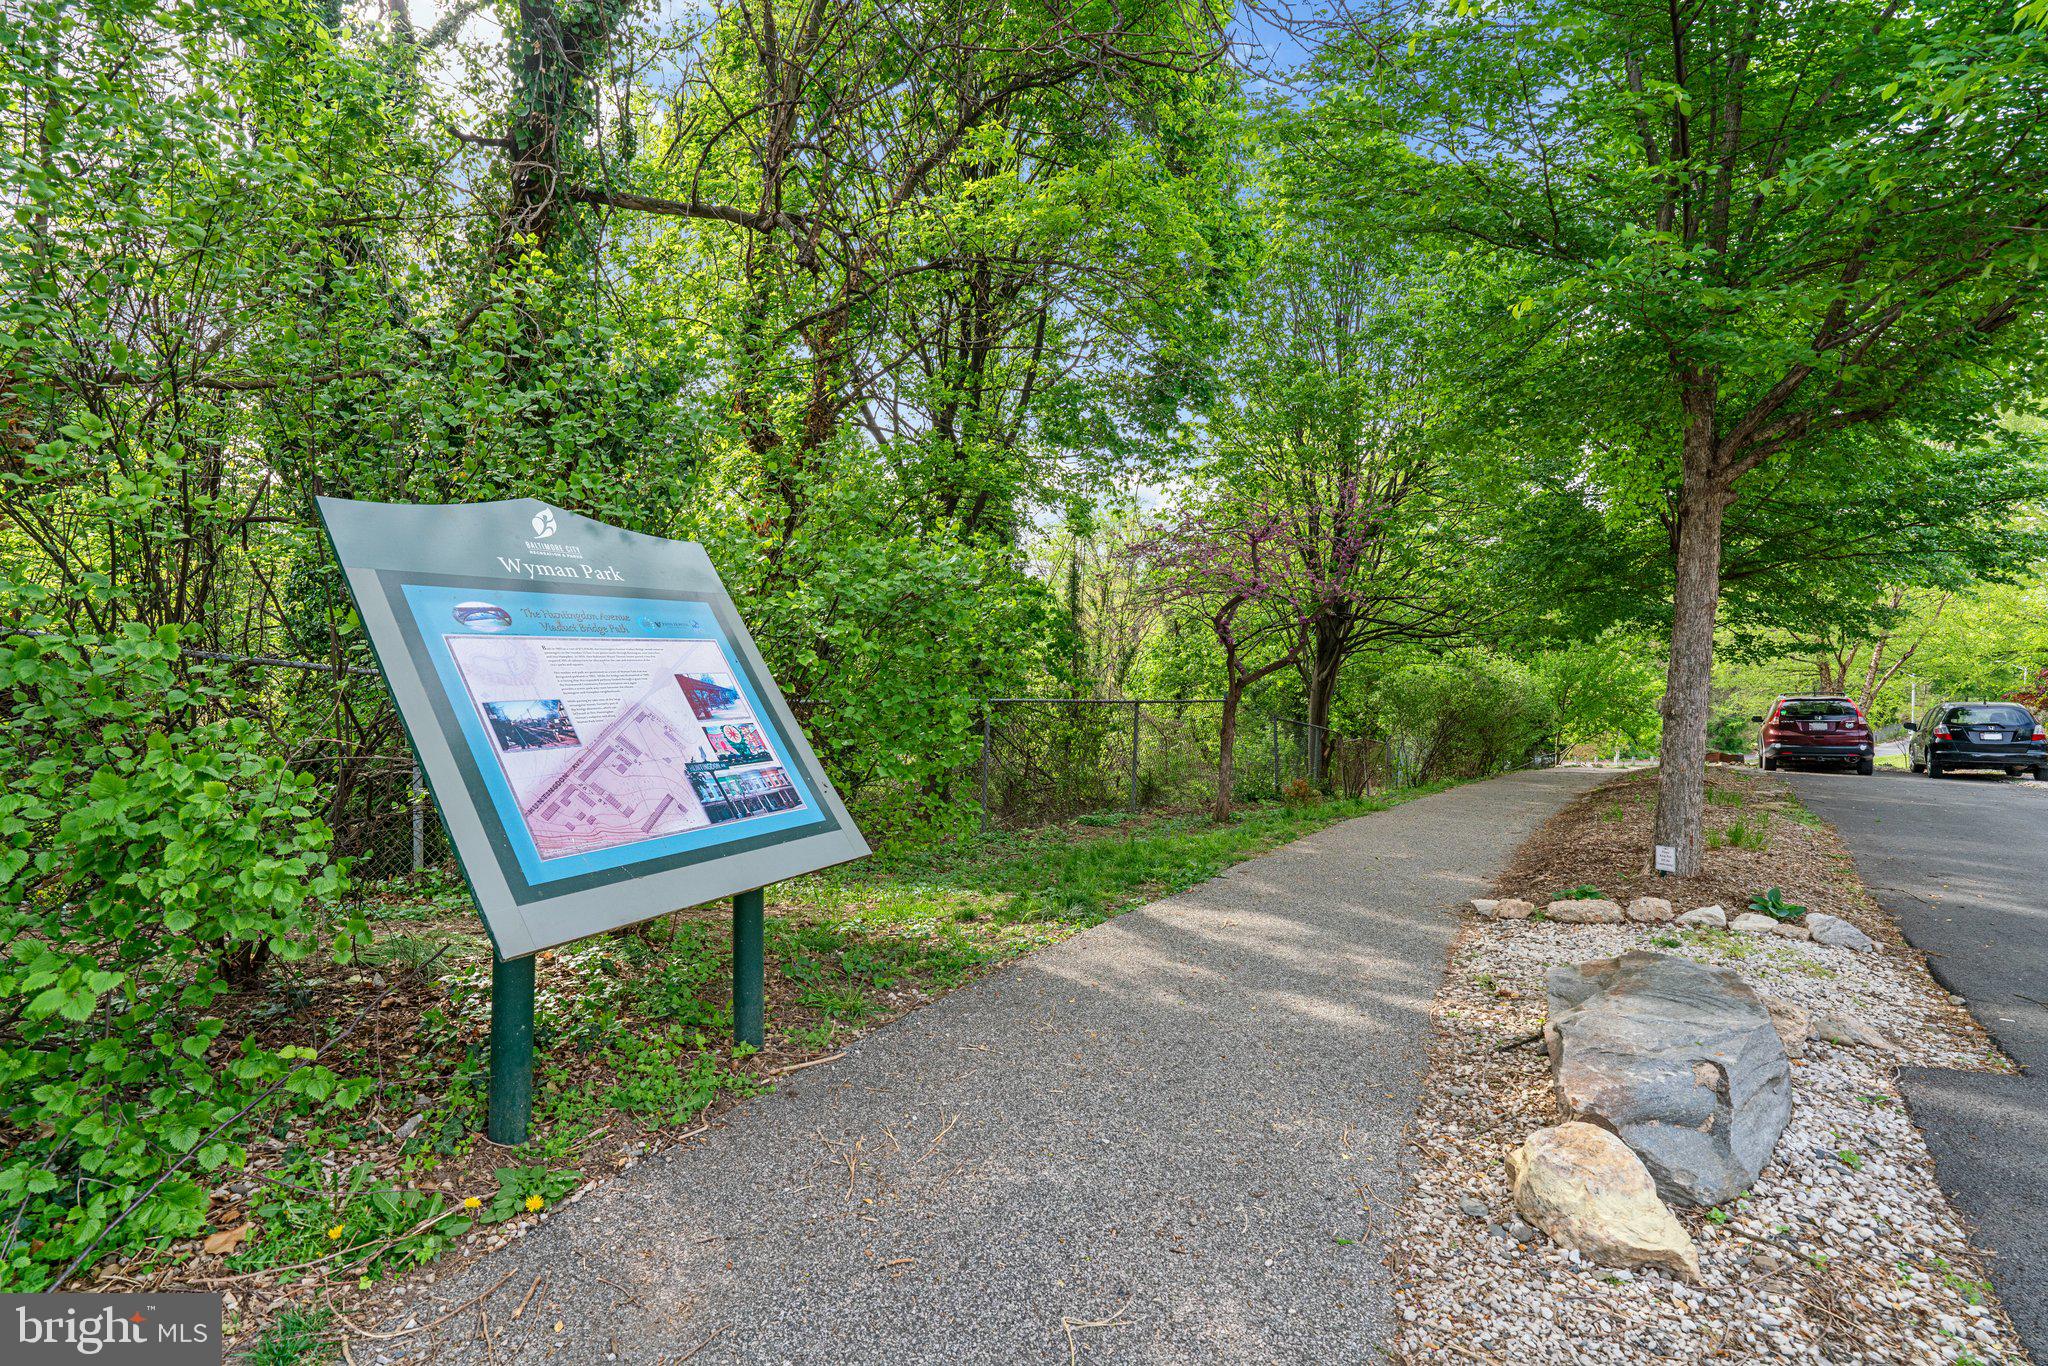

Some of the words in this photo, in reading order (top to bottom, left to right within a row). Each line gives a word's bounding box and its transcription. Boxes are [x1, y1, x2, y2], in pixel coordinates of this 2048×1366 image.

[525, 541, 563, 552] BALTIMORE
[565, 545, 580, 554] CITY
[497, 557, 579, 580] Wyman
[580, 563, 625, 582] Park
[521, 608, 540, 619] The
[540, 608, 598, 622] Huntingdon
[539, 621, 577, 633] Viaduct
[578, 623, 607, 636] Bridge
[608, 623, 630, 634] Path
[528, 772, 569, 816] HUNTINGDON
